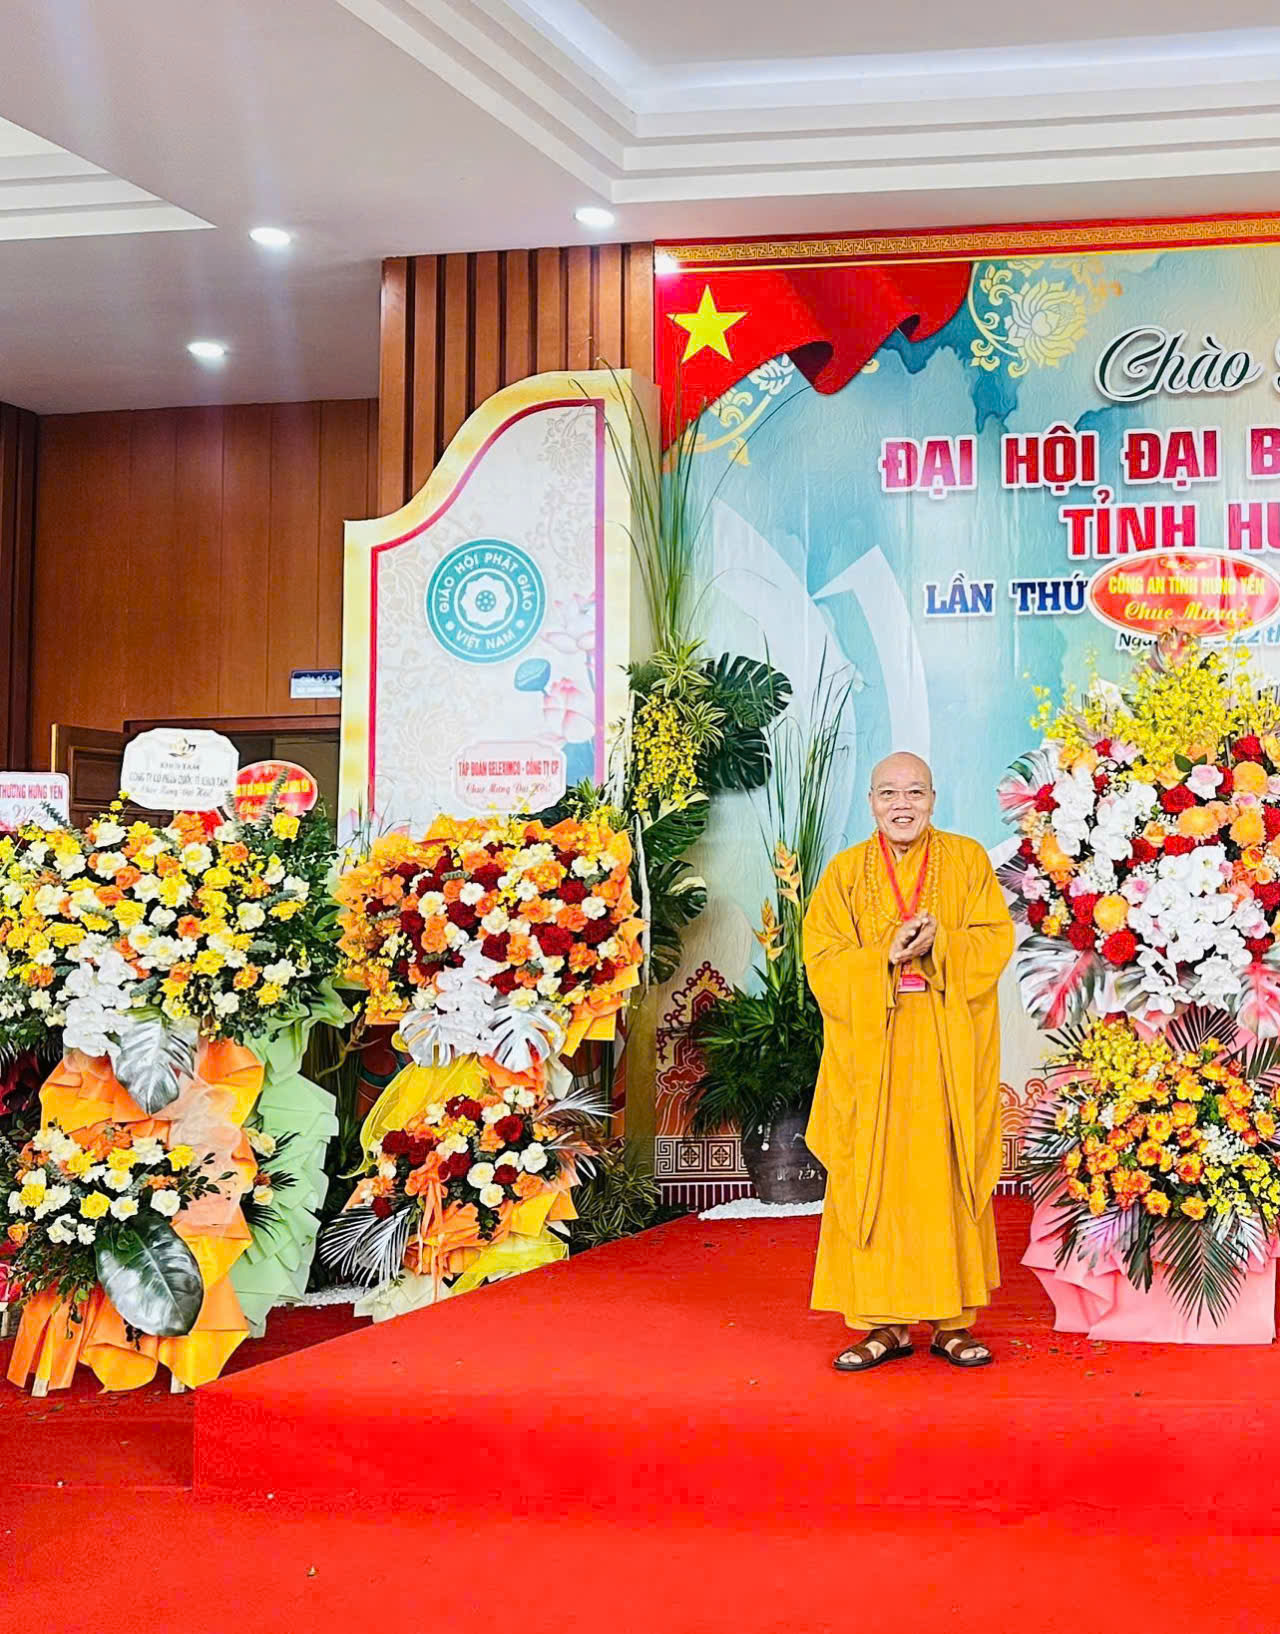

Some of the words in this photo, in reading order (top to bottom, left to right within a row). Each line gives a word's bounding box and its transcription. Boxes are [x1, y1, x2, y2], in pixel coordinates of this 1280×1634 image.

[1098, 326, 1262, 399] Chào
[882, 438, 974, 494] ĐẠI
[1004, 424, 1096, 492] HỘI
[1124, 430, 1218, 487] ĐẠI
[1062, 489, 1197, 555] TỈNH
[438, 576, 455, 613] GIÁO
[454, 553, 479, 574] HỘI
[484, 552, 518, 573] PHẬT
[517, 574, 535, 611] GIÁO
[926, 571, 995, 614] LẦN
[1012, 571, 1089, 613] THỨ
[1108, 572, 1144, 595] CÔNG
[1146, 575, 1165, 595] AN
[1169, 572, 1197, 595] TỈNH
[1240, 573, 1265, 595] YÊN
[456, 629, 480, 649] VIỆT
[486, 629, 516, 649] NAM
[28, 783, 48, 799] HƯNG
[50, 783, 63, 800] YÊN
